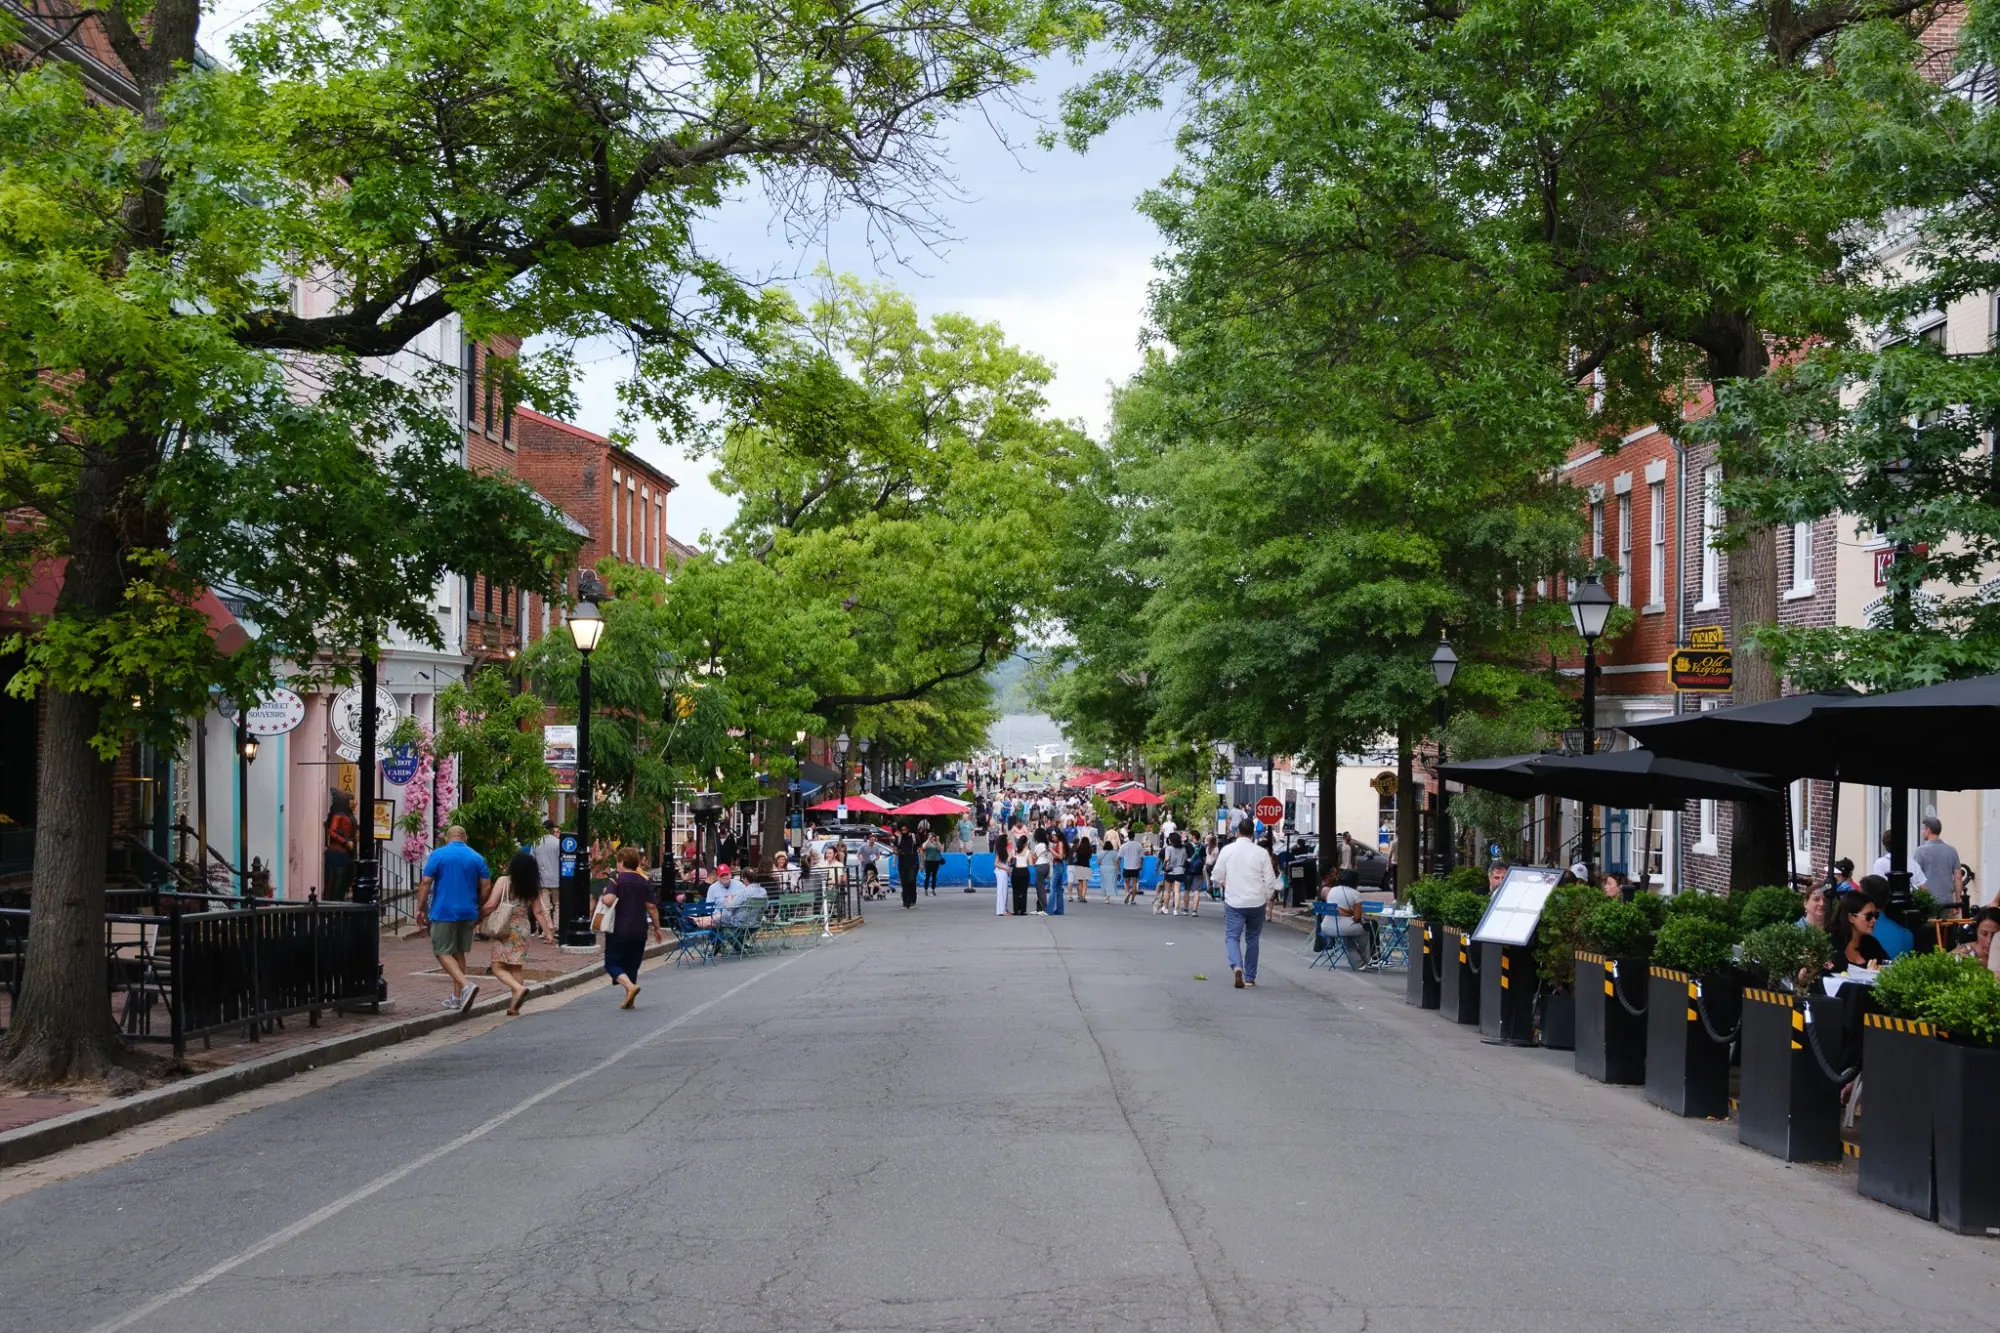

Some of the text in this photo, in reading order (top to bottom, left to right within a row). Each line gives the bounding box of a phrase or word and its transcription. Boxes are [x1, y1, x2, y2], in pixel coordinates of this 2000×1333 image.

[1702, 656, 1729, 667] Old
[1691, 662, 1733, 676] Virginia
[338, 725, 391, 747] TOBACNIST
[341, 748, 384, 760] CIGS
[1257, 805, 1282, 817] STOP
[567, 840, 573, 850] P
